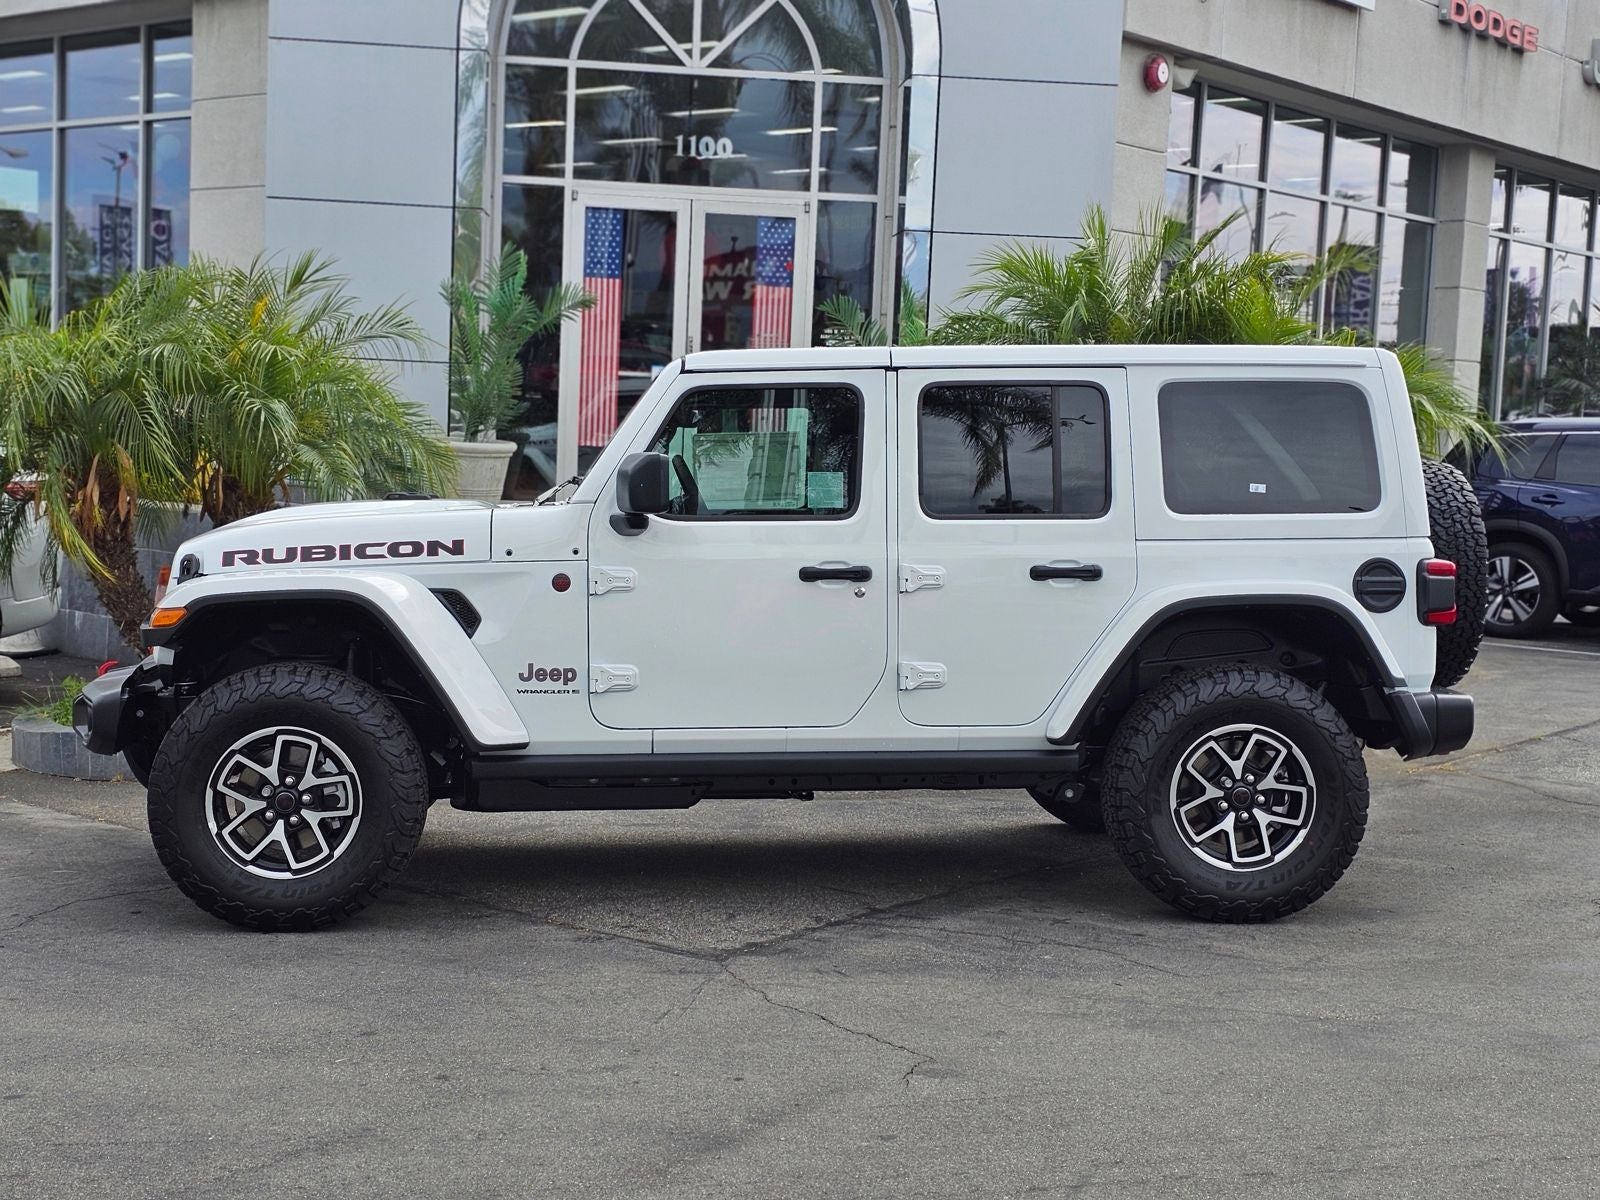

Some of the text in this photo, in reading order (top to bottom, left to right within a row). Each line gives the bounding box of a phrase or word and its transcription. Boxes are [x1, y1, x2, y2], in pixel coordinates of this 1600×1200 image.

[1450, 0, 1539, 52] DODGE
[673, 134, 734, 158] 1100
[221, 538, 465, 567] RUBICON
[518, 662, 577, 686] Jeep
